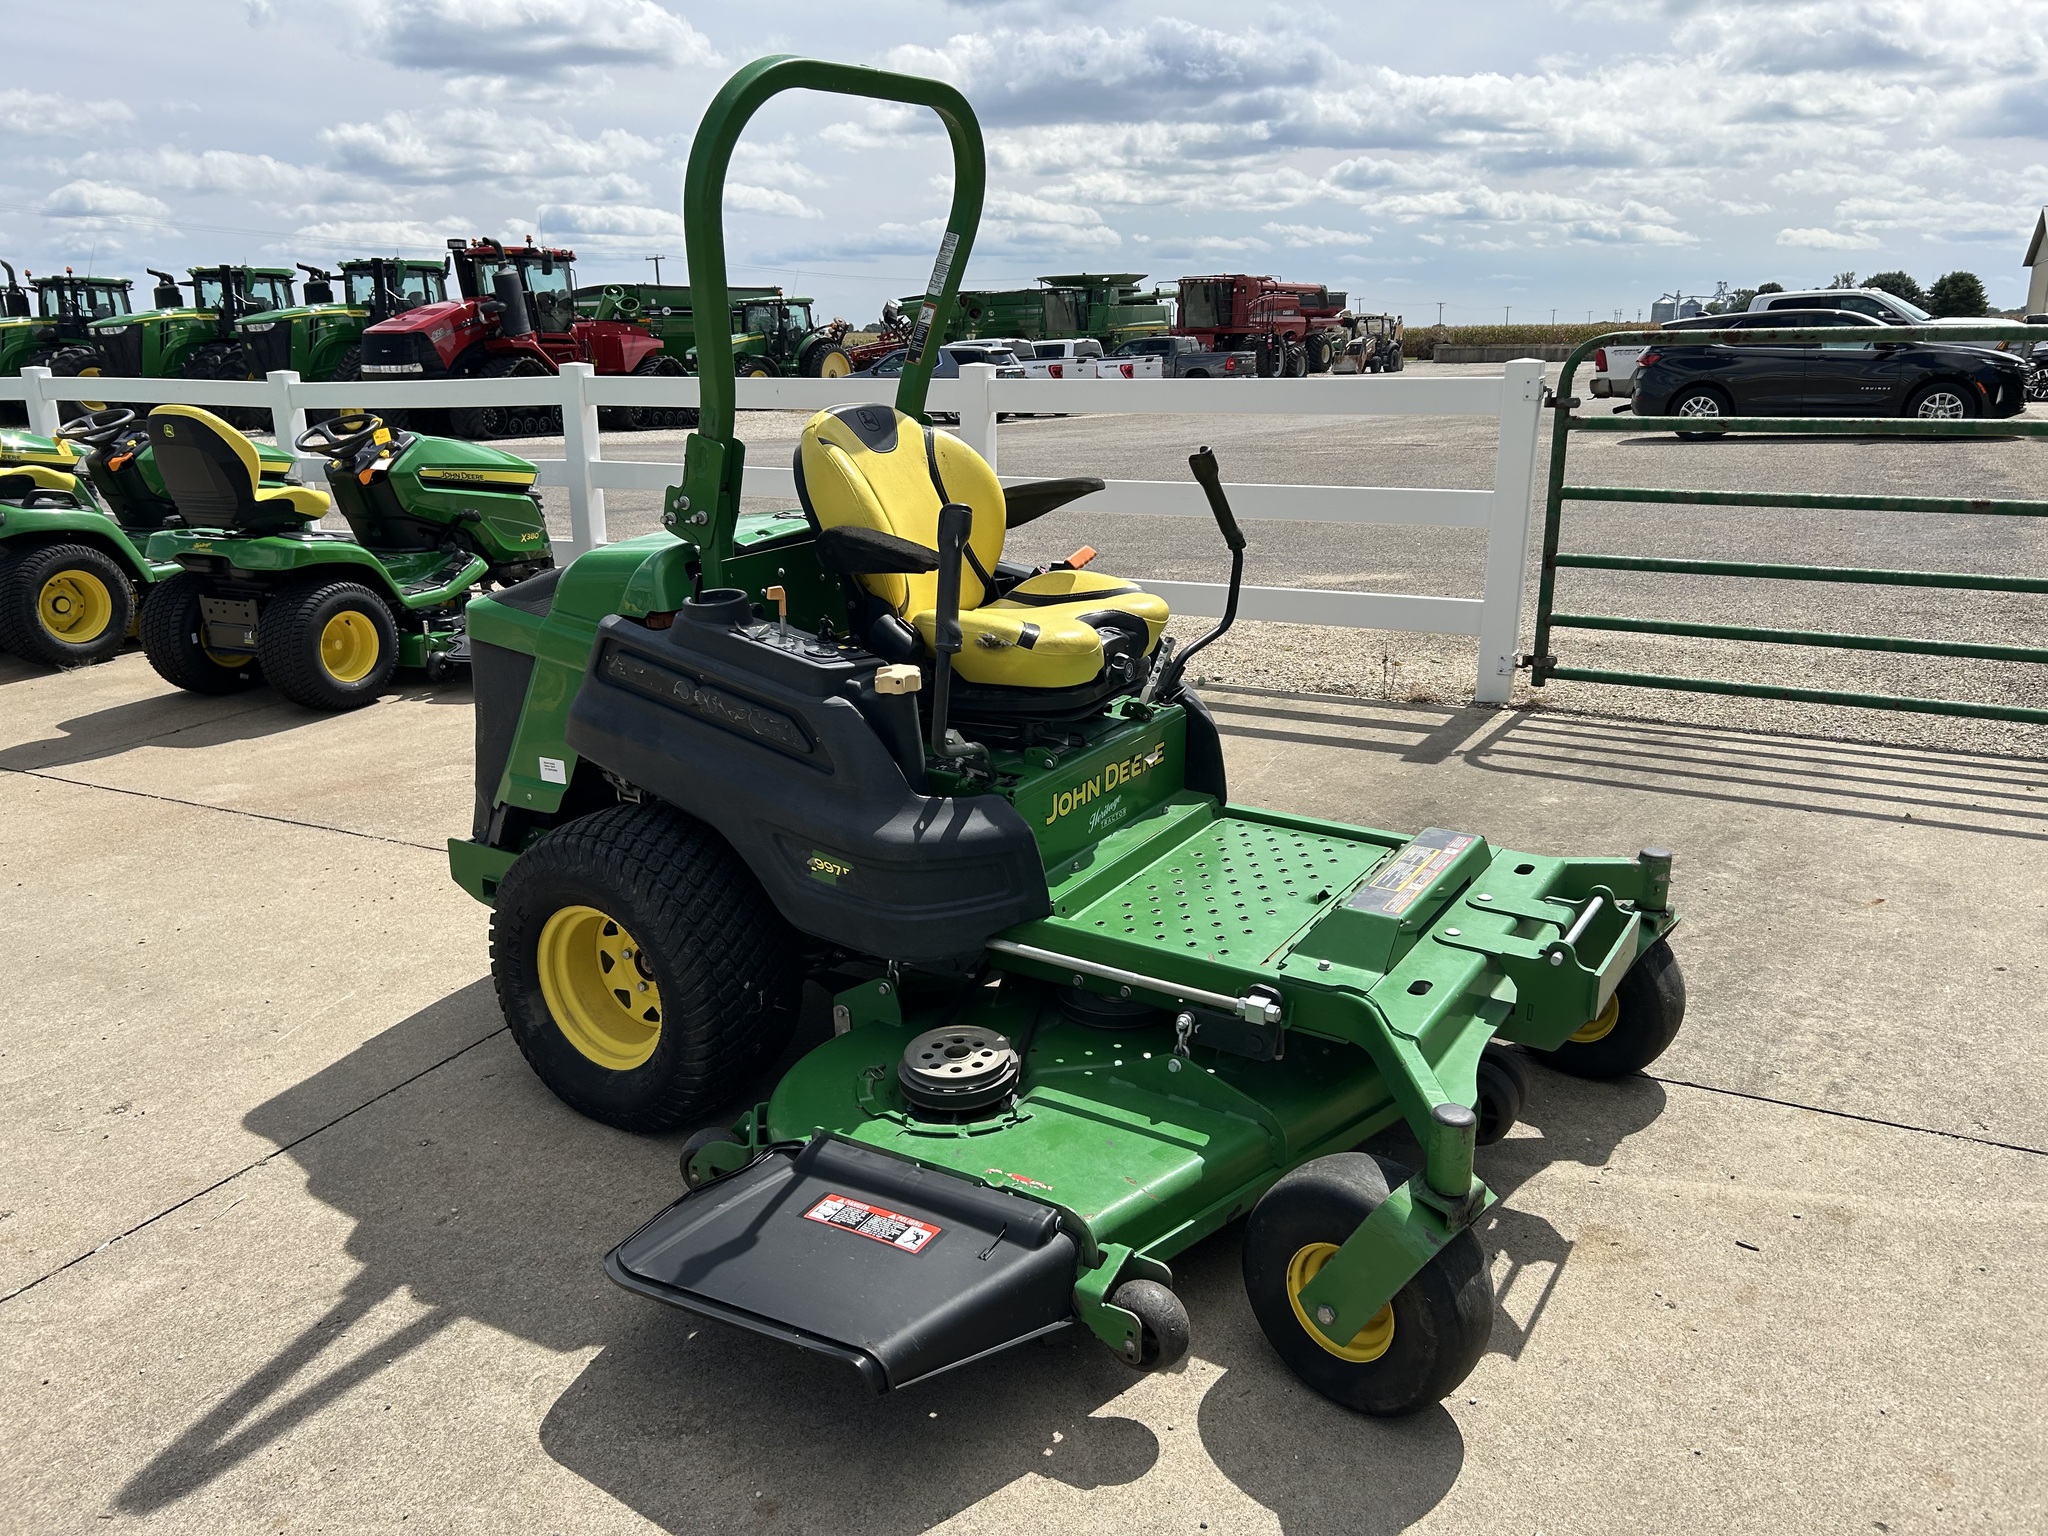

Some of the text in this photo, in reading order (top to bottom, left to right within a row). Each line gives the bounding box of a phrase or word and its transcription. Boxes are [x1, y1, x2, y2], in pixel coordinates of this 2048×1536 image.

[441, 470, 485, 480] JOHN DEERE
[521, 532, 539, 542] X380
[1046, 775, 1100, 825] JOHN
[1088, 795, 1122, 834] Heritage
[1101, 807, 1127, 827] TRACTOR
[811, 857, 850, 876] 997
[895, 1215, 925, 1228] PELIGRO
